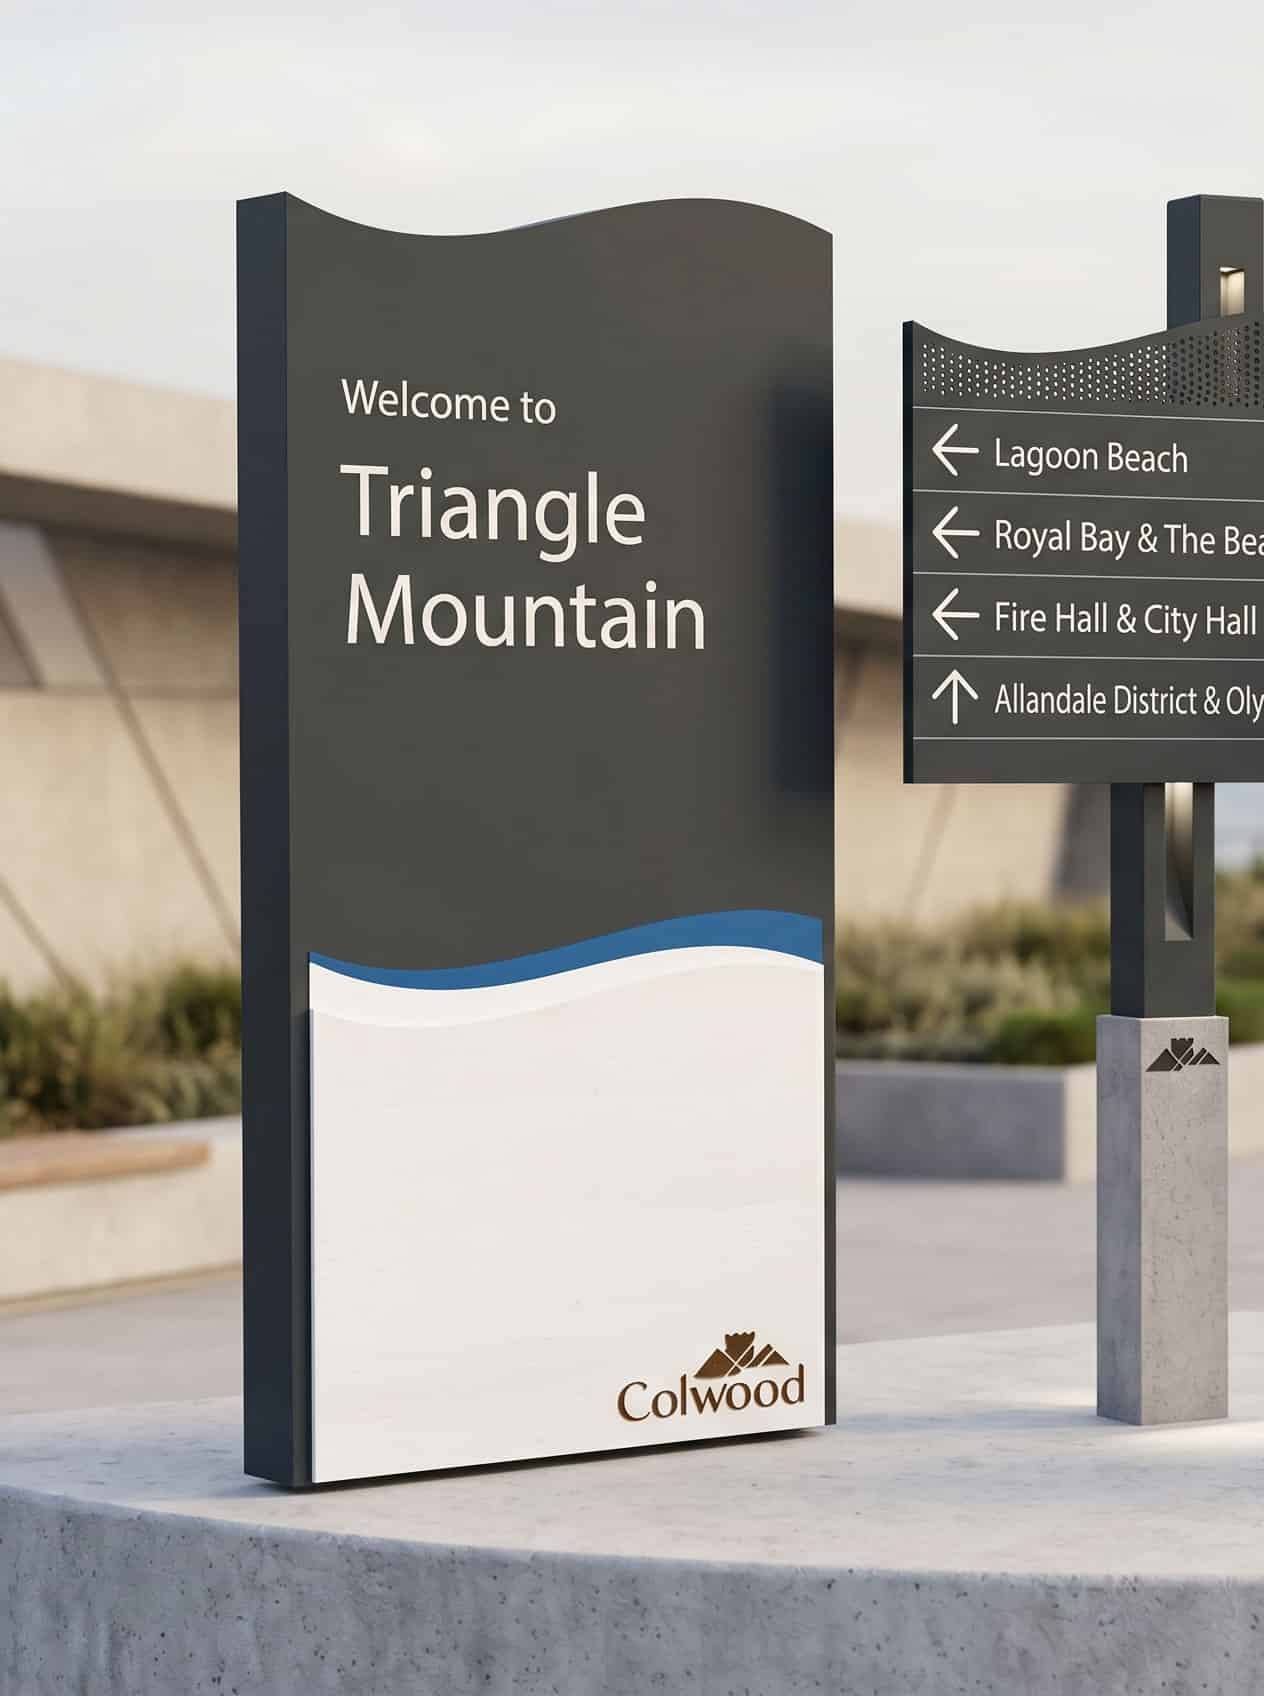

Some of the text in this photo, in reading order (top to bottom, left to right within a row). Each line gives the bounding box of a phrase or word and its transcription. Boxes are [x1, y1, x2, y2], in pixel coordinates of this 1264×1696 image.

[342, 379, 555, 424] Welcome to
[996, 438, 1187, 476] Lagoon Beach
[340, 465, 645, 562] Triangle
[996, 520, 1070, 558] Royal
[1082, 522, 1130, 560] Bay
[1138, 523, 1157, 552] &
[1165, 524, 1215, 554] The
[348, 574, 704, 649] Mountain
[996, 602, 1256, 642] Fire Hall & City Hall
[995, 683, 1106, 714] Allandale
[1115, 685, 1197, 714] District
[1204, 686, 1220, 714] &
[617, 1363, 804, 1421] Colwood
